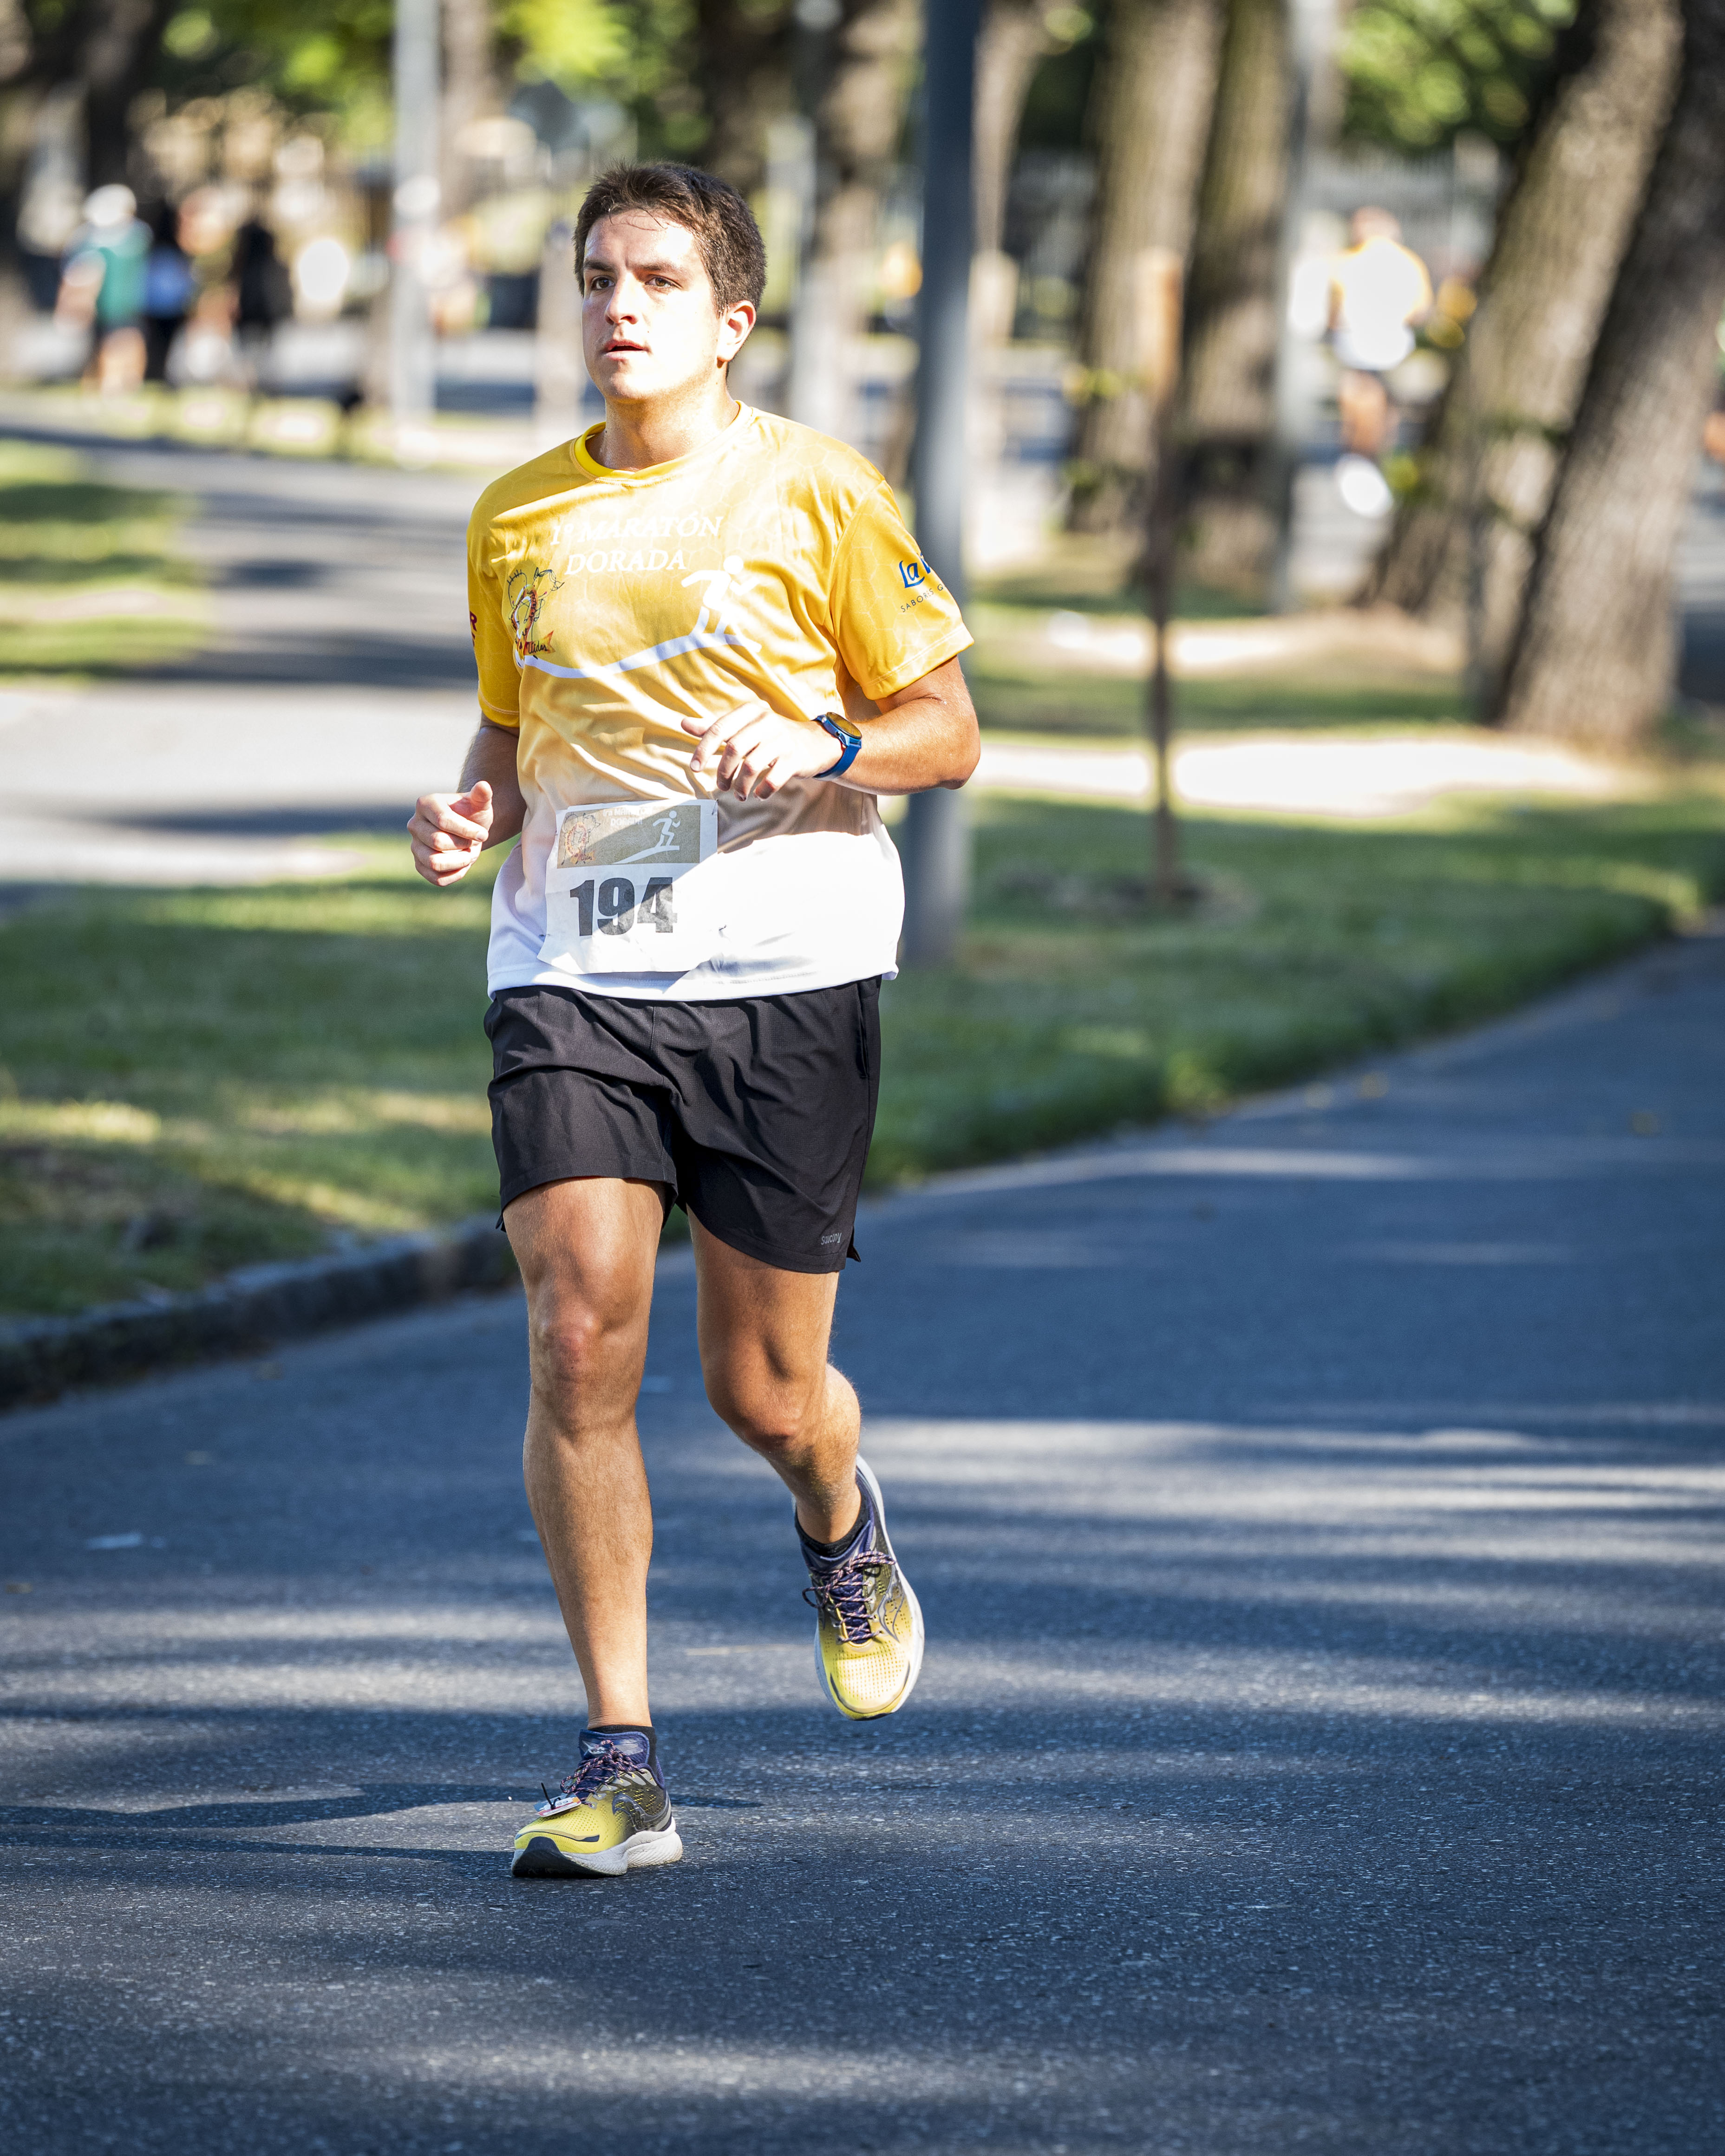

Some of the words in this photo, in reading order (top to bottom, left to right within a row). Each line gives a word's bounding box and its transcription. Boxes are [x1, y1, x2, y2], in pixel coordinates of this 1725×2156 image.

[577, 511, 724, 543] MARATÓN
[564, 549, 686, 575] DORADA
[899, 560, 925, 588] La
[569, 877, 678, 937] 194
[821, 1232, 842, 1245] saucony
